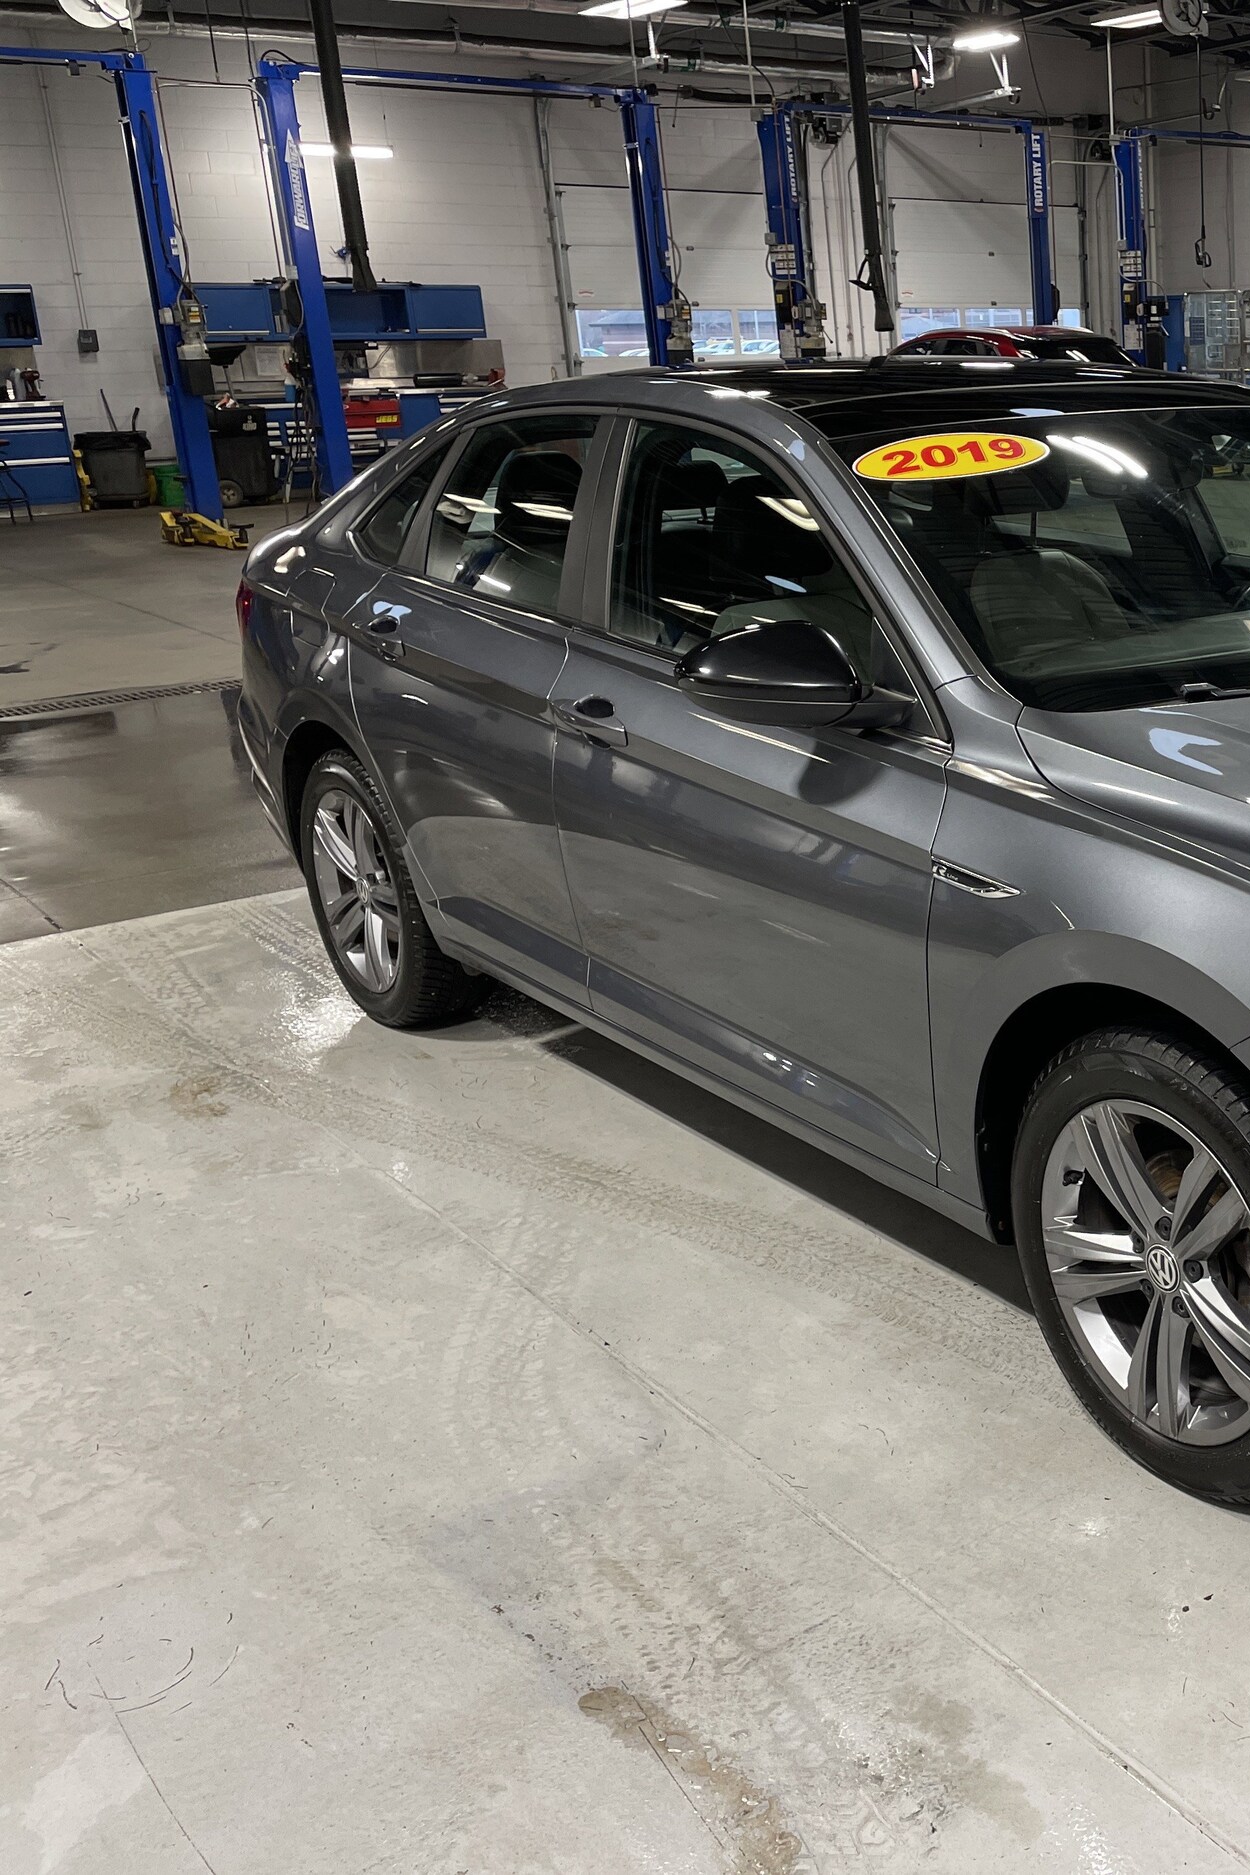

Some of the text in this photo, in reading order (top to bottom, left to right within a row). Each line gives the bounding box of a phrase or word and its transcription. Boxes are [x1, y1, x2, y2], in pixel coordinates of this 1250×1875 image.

[784, 115, 797, 196] ROTARY LIFT
[1031, 133, 1044, 207] ROTARY LIFT
[882, 438, 1026, 477] 2019
